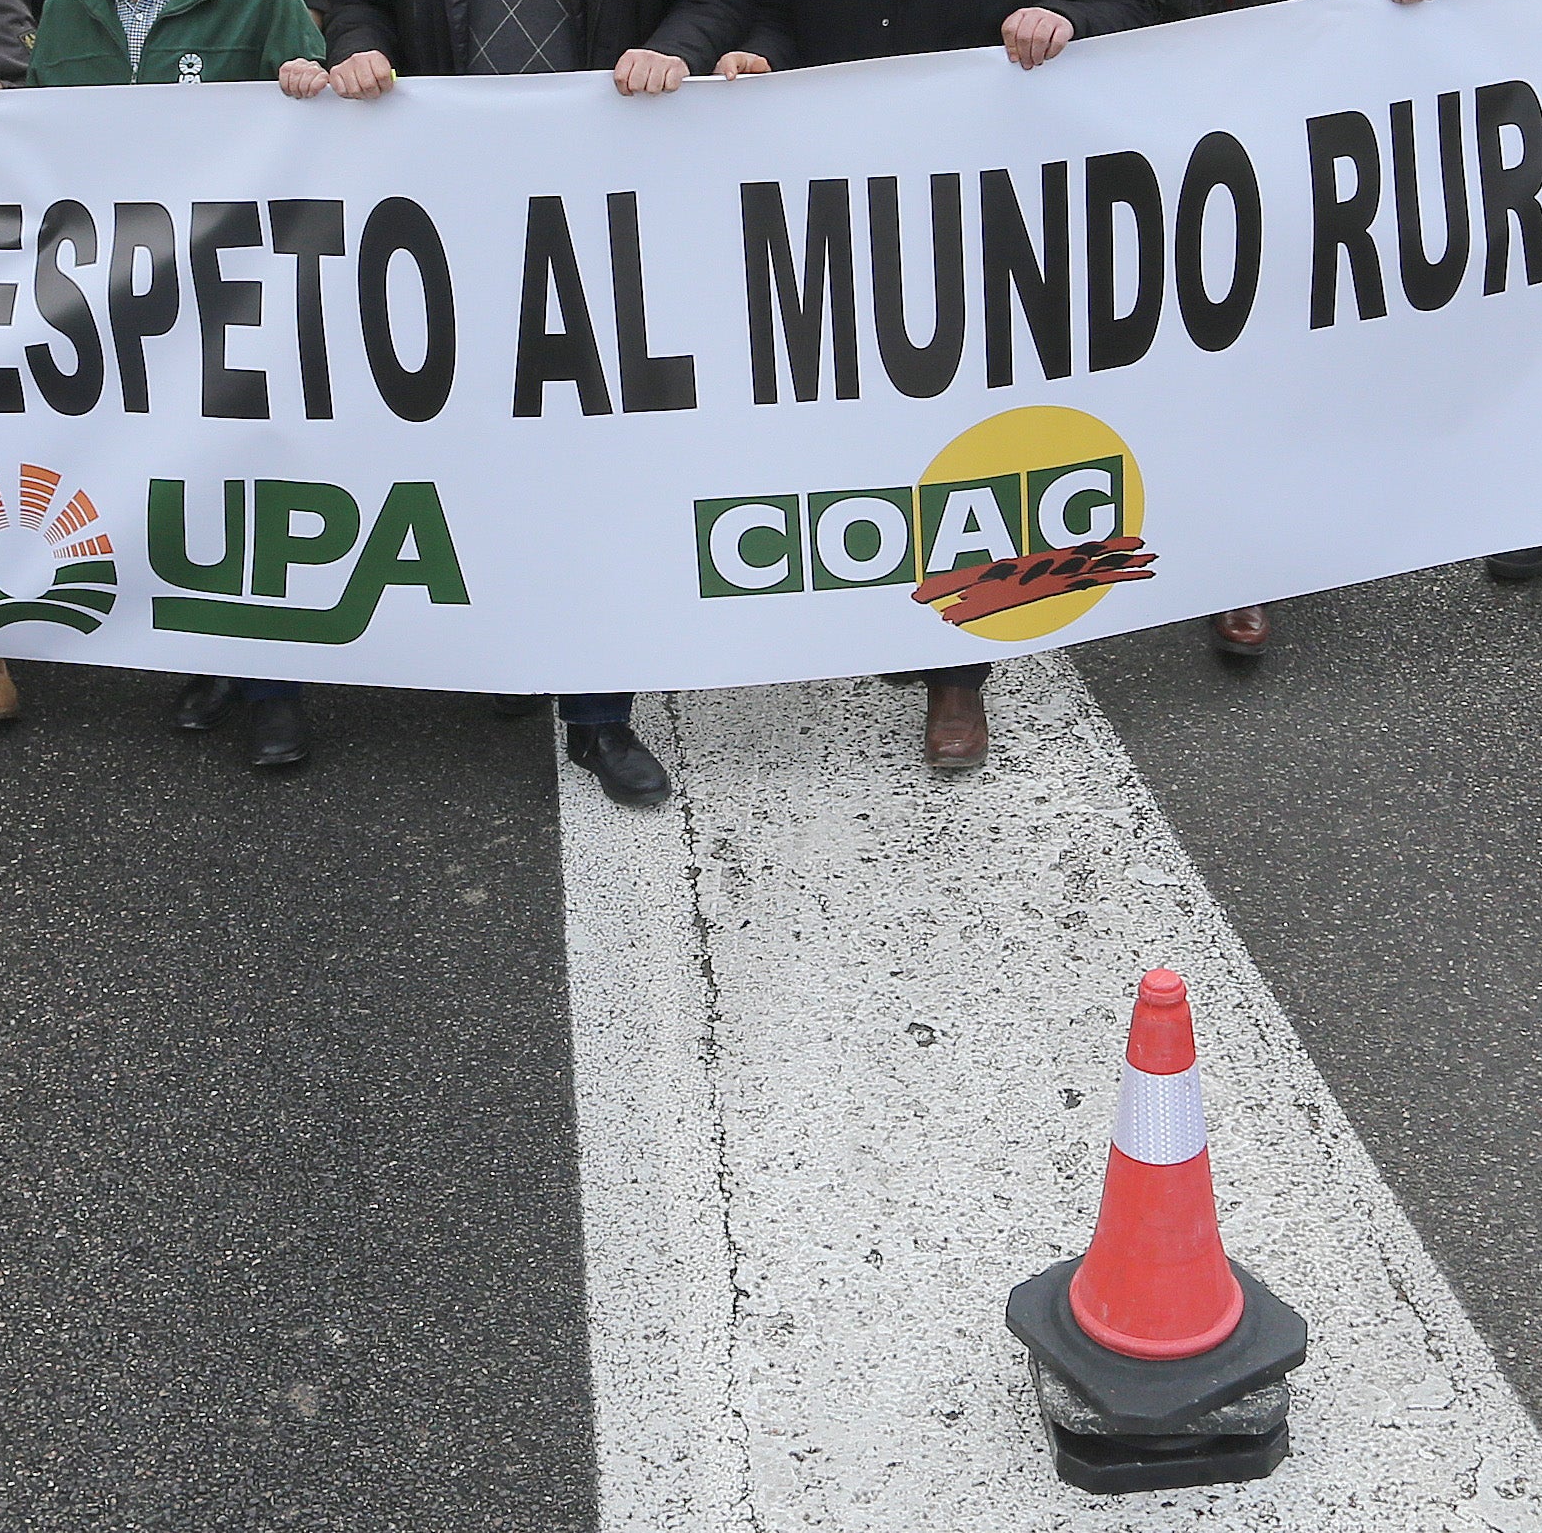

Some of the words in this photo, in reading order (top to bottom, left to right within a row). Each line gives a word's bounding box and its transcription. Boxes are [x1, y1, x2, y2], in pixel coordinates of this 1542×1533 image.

[512, 190, 697, 418] AL
[740, 130, 1262, 407] MUNDO
[147, 476, 471, 644] UPA
[702, 463, 1120, 593] COAG
